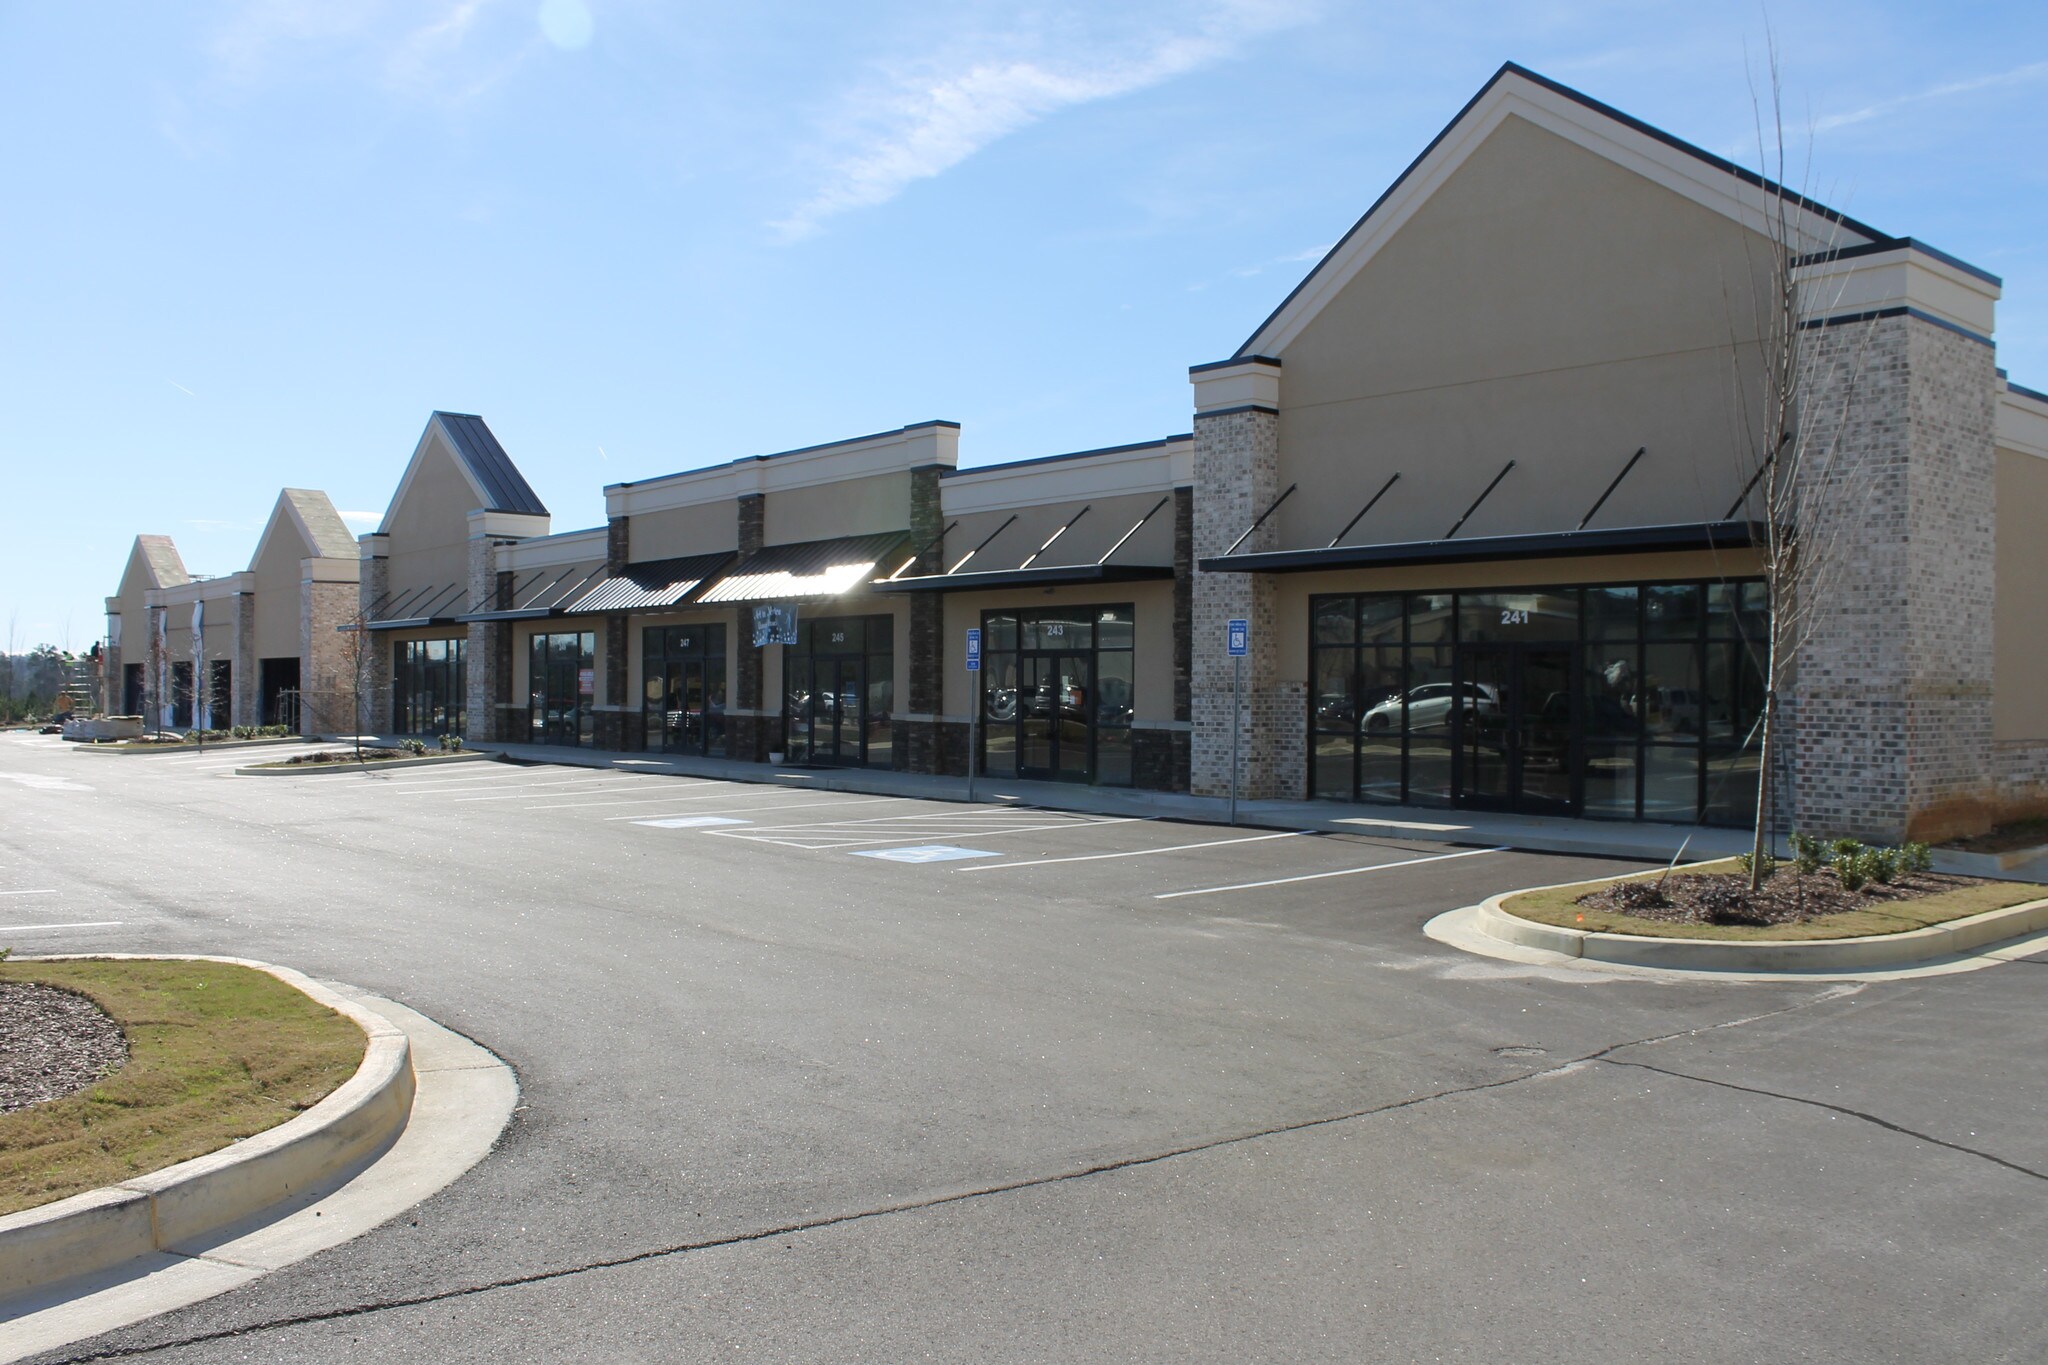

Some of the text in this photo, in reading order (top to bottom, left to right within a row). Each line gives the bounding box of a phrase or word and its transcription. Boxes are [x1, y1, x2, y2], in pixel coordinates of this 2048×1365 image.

[1501, 610, 1528, 624] 241
[1047, 625, 1063, 635] 243
[680, 638, 690, 647] 247
[832, 633, 844, 643] 245
